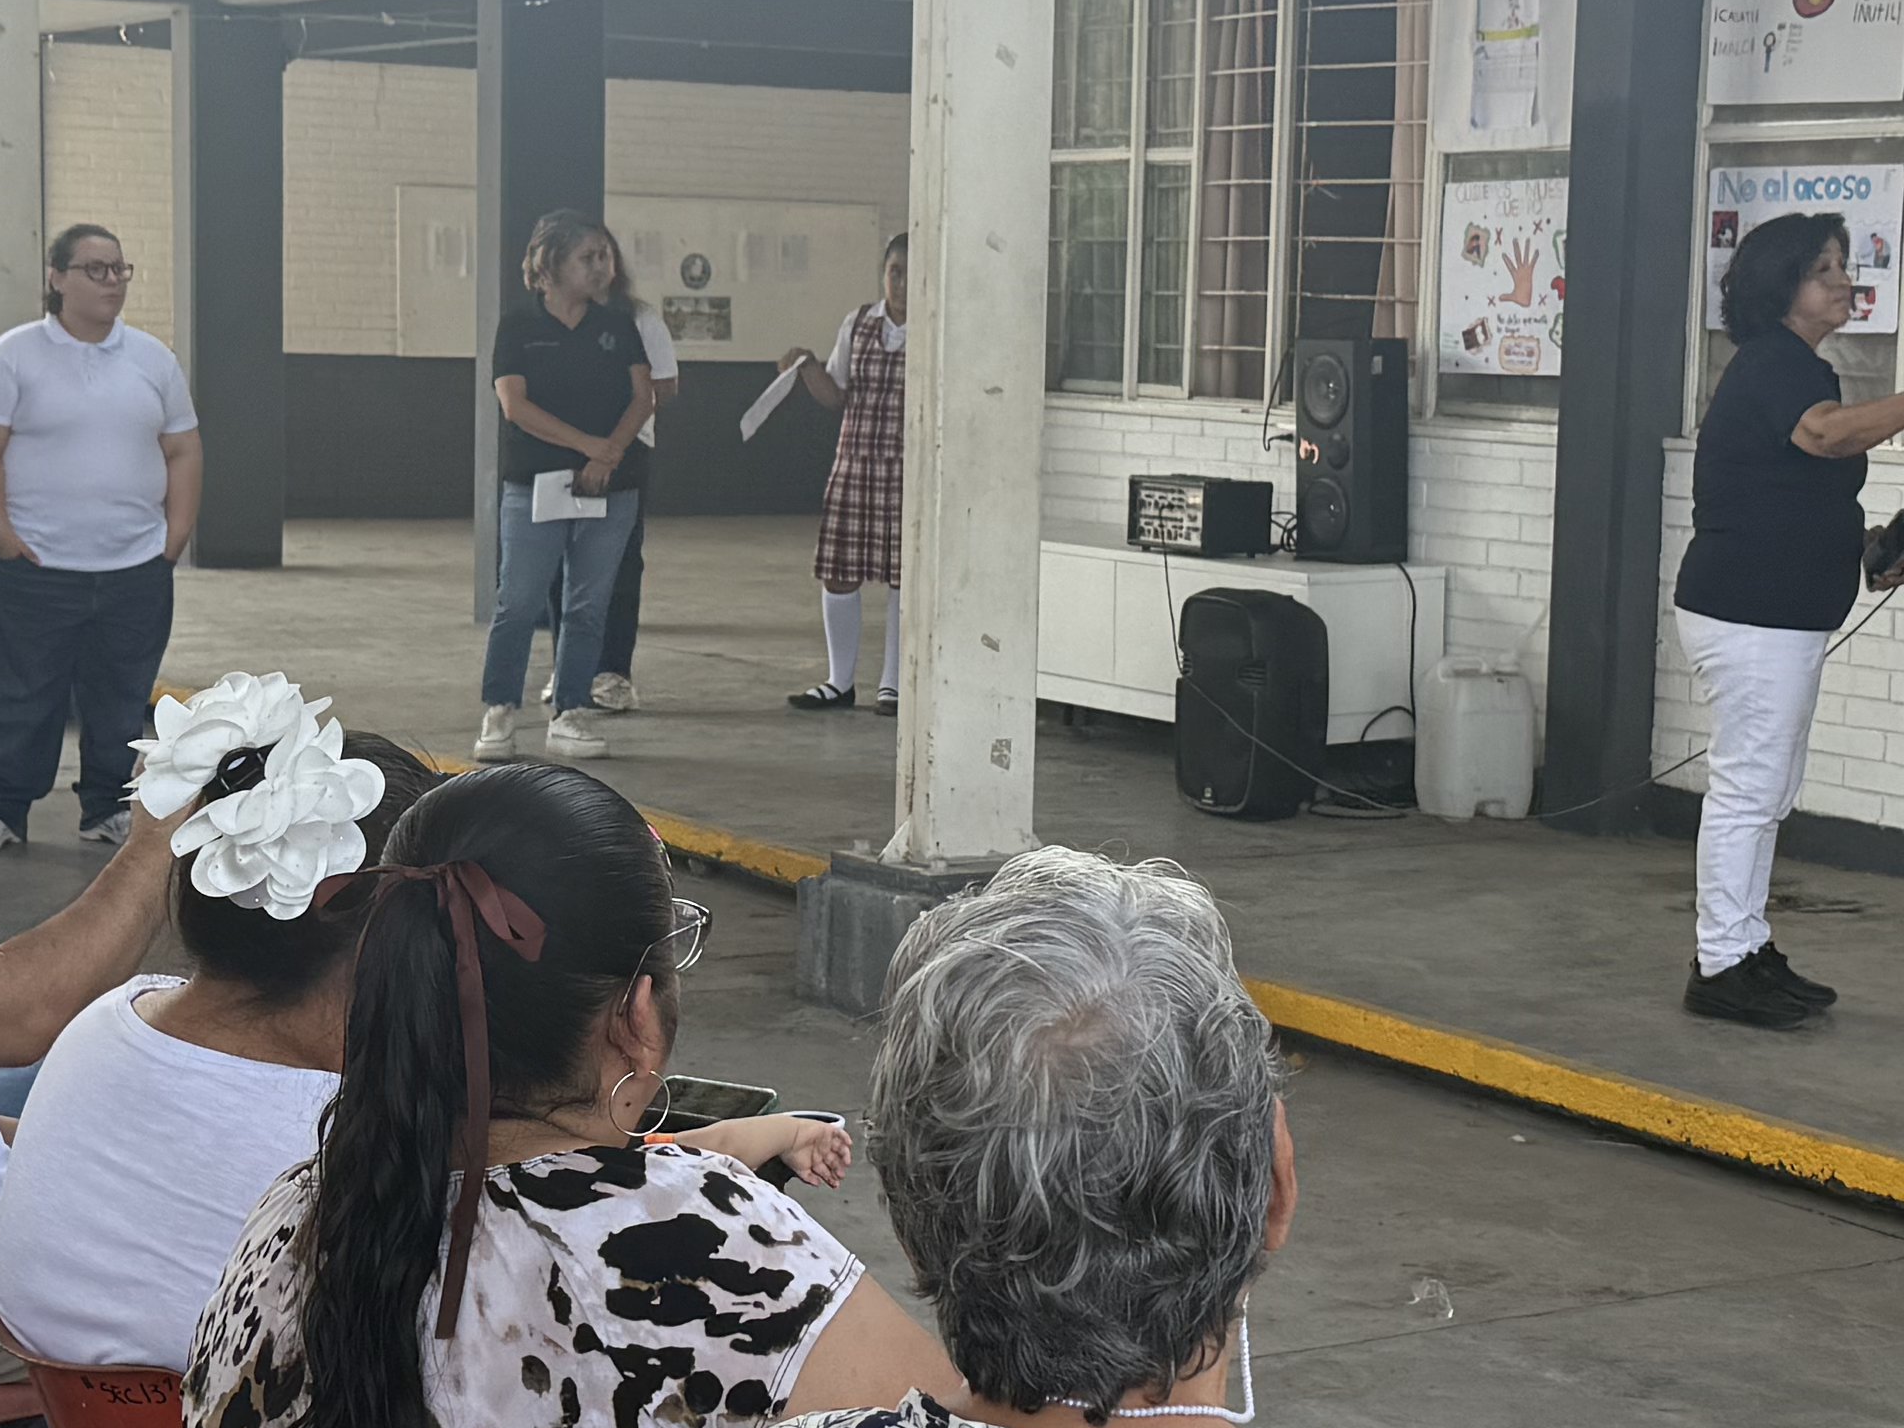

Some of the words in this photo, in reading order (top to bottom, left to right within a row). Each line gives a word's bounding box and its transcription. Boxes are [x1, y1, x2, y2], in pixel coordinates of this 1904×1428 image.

[1716, 169, 1758, 204] No
[1762, 169, 1789, 202] al
[1793, 174, 1872, 201] acoso
